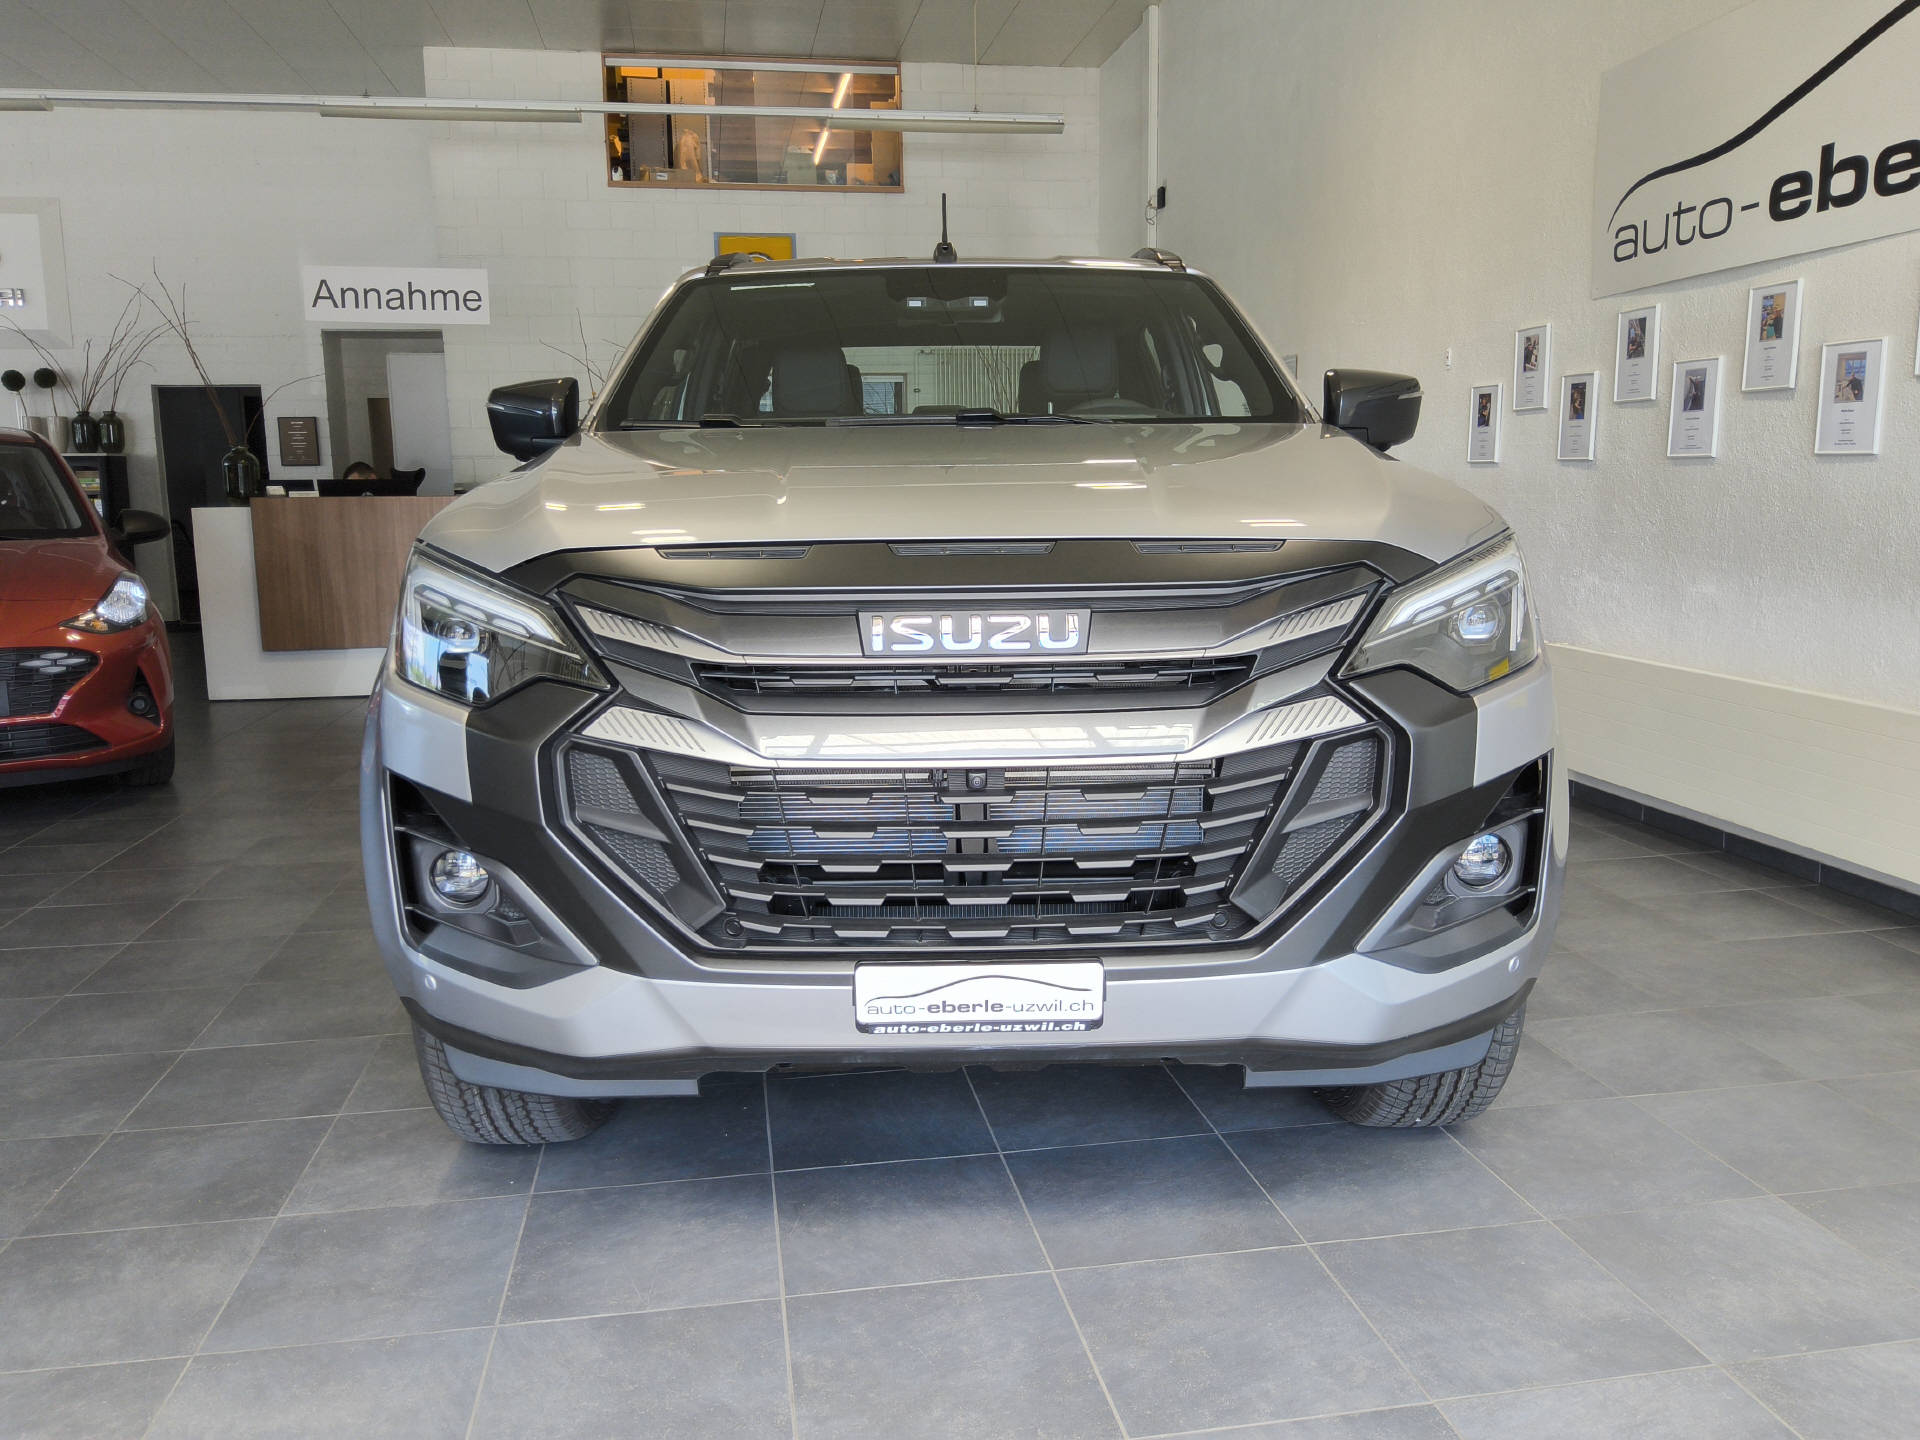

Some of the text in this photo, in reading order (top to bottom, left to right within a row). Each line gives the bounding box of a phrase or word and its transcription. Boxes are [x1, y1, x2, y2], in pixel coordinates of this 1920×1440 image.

[312, 279, 483, 312] Annahme
[871, 612, 1079, 652] ISUZU
[867, 999, 1095, 1015] auto-eberle-uzwil.ch
[873, 1021, 1086, 1034] auto-eberle-uzwil.ch
